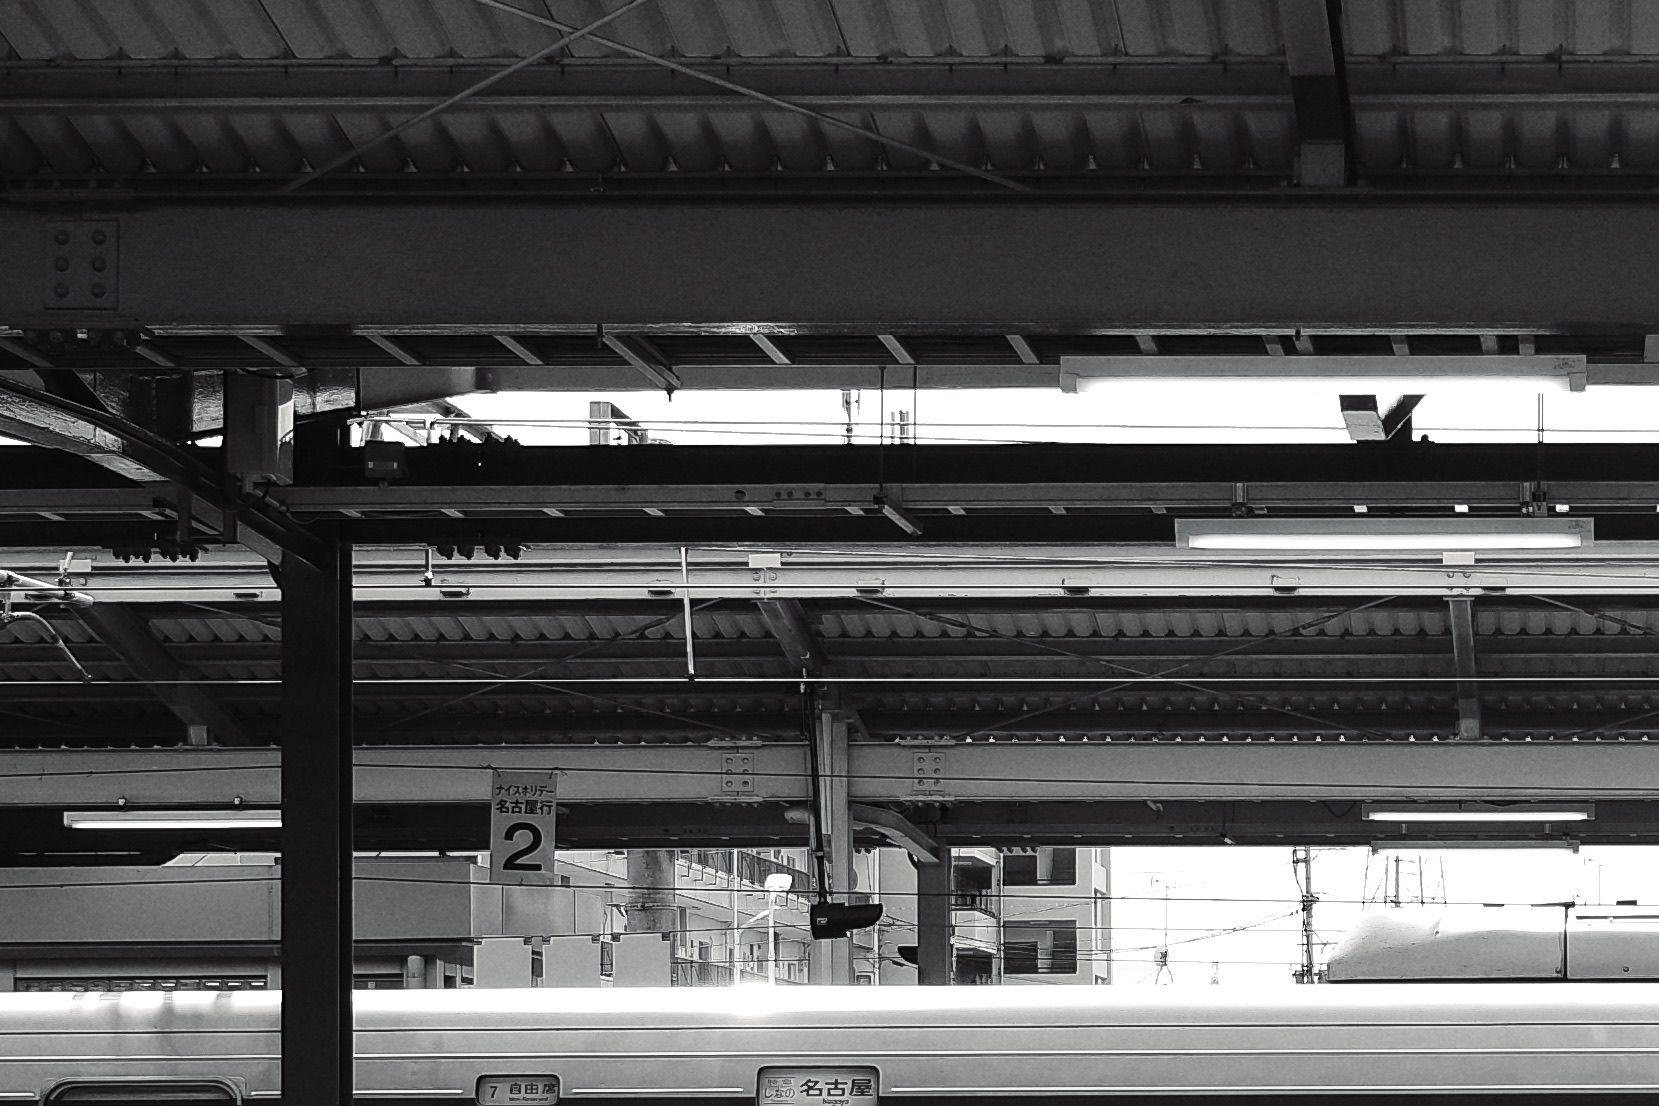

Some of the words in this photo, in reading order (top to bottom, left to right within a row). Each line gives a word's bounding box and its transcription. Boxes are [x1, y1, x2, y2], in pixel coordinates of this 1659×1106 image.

[495, 784, 555, 797] ナイスホリデー
[495, 799, 554, 815] 名古屋行
[503, 822, 542, 871] 2
[489, 1085, 499, 1099] 7
[508, 1082, 558, 1095] 自由席
[764, 1087, 796, 1099] しなの
[800, 1078, 874, 1097] 名古屋
